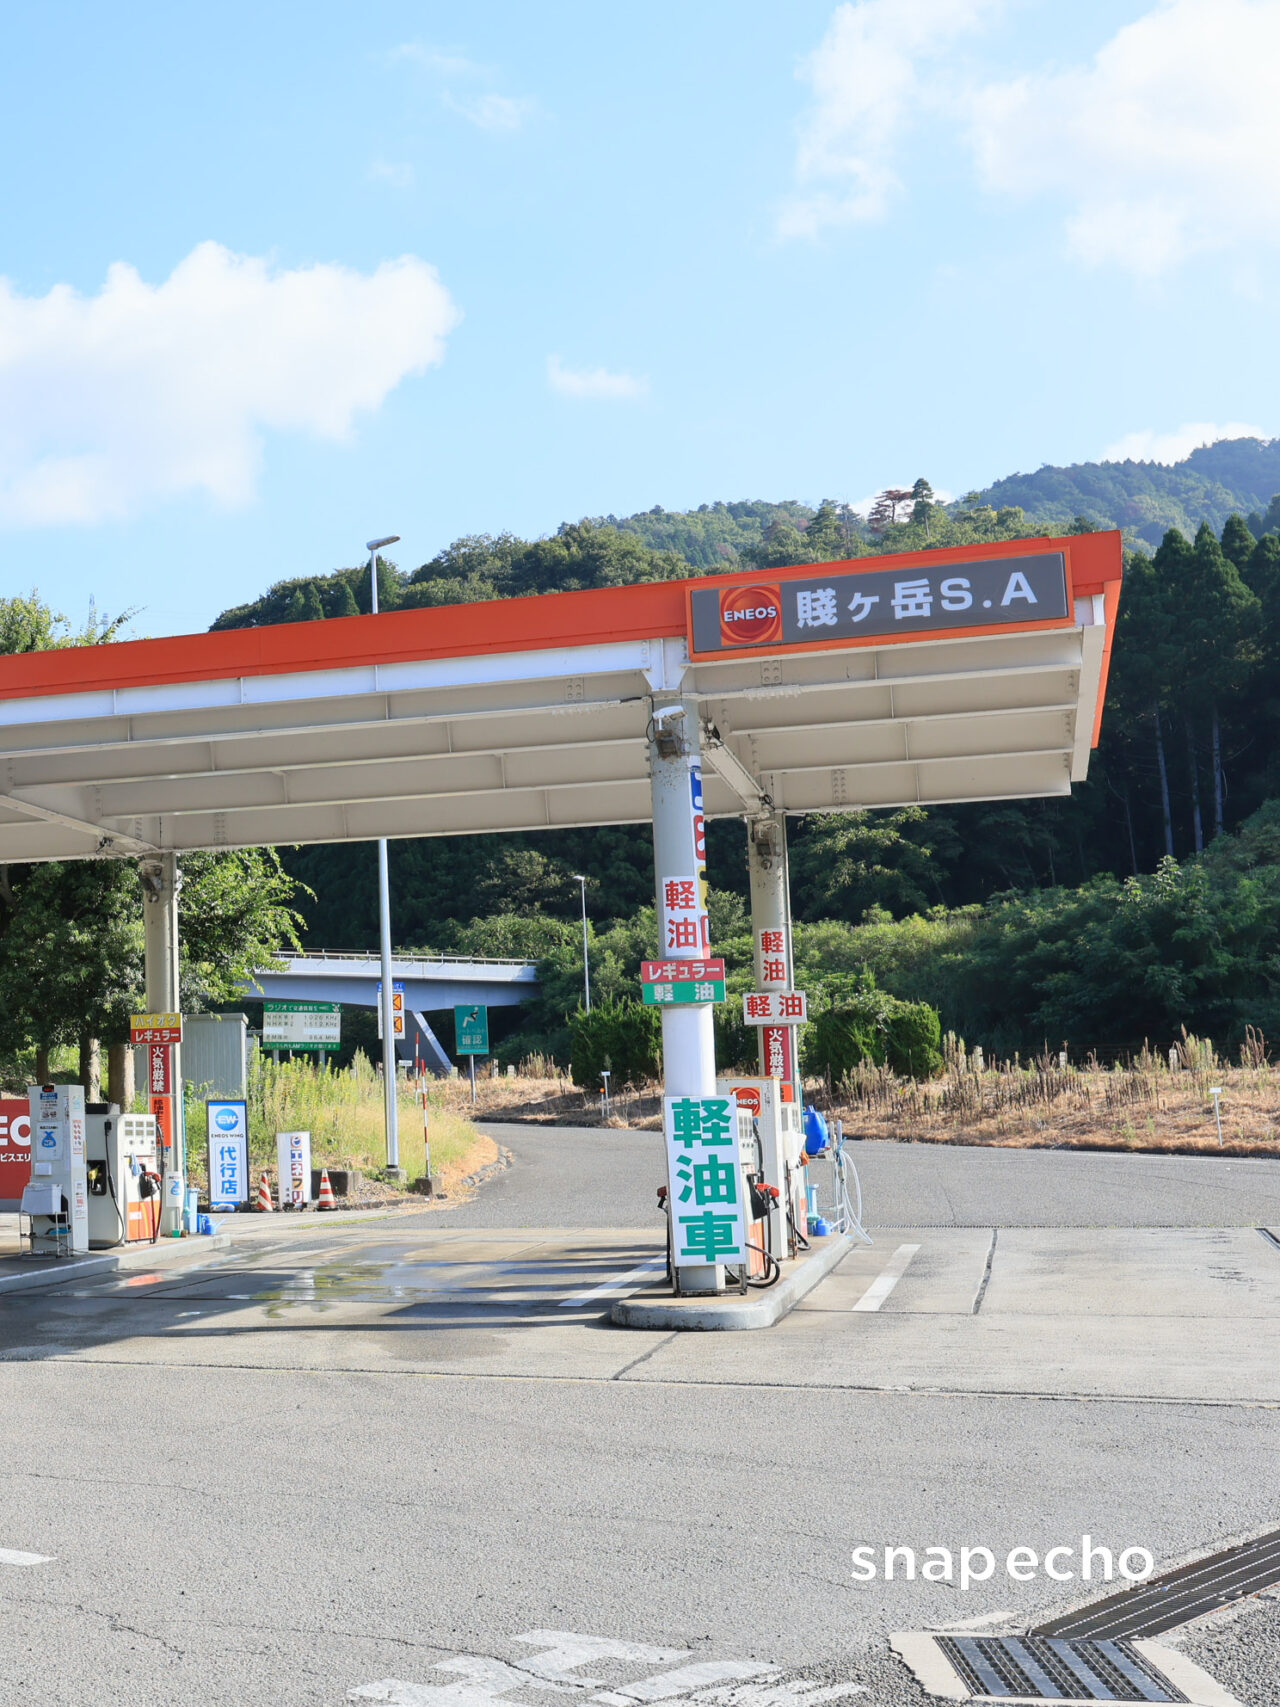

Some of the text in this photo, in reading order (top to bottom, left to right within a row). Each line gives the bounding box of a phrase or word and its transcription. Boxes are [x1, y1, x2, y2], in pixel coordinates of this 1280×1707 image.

[723, 606, 777, 622] ENEOS
[665, 880, 698, 948] 軽油
[648, 962, 722, 981] レギュラー
[761, 931, 787, 982] 軽油
[653, 982, 716, 1002] 軽油
[746, 994, 803, 1019] 軽油
[135, 1016, 177, 1027] ハイオク
[135, 1030, 179, 1041] レギュラー
[152, 1047, 164, 1092] 火気厳禁
[768, 1029, 785, 1079] 火気厳禁
[219, 1146, 238, 1194] 代行店
[671, 1098, 740, 1262] 軽油車
